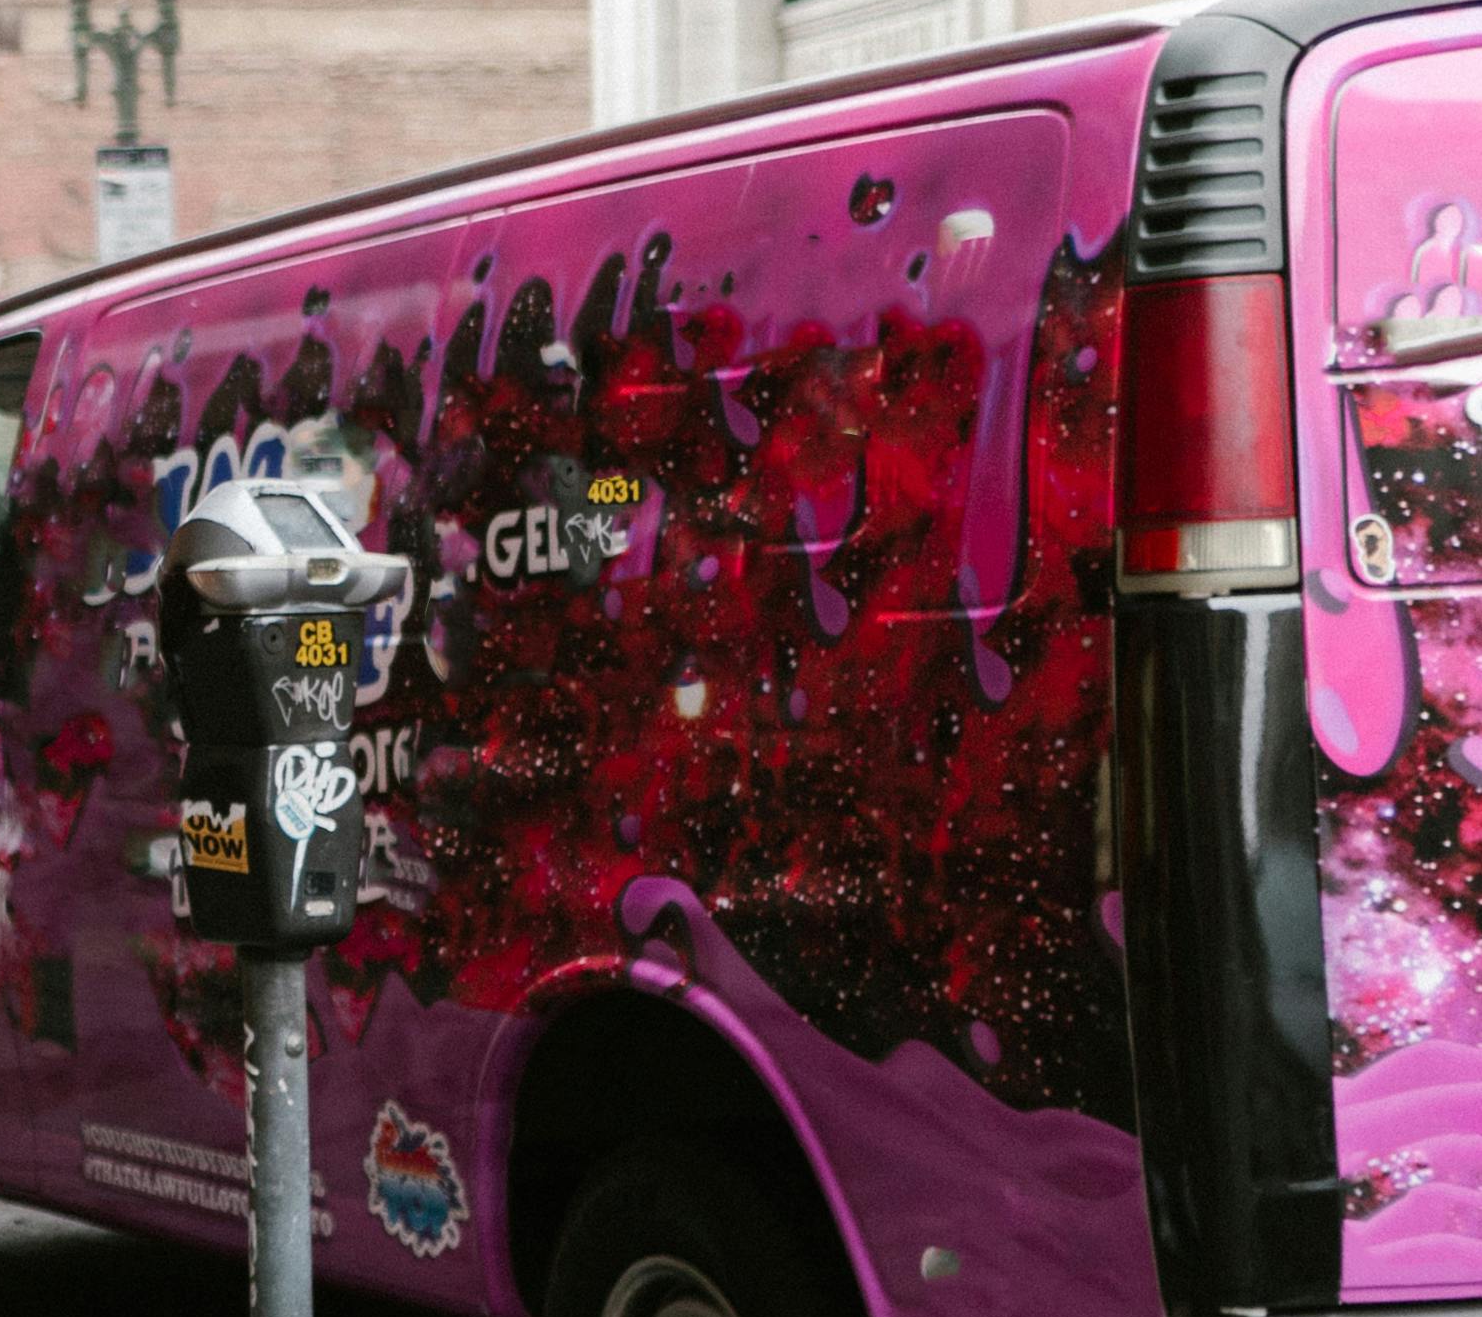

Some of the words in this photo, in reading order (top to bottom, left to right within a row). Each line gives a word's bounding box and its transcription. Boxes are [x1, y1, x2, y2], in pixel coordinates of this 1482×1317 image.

[587, 479, 640, 504] 4031
[299, 619, 334, 646] CB
[295, 642, 349, 668] 4031
